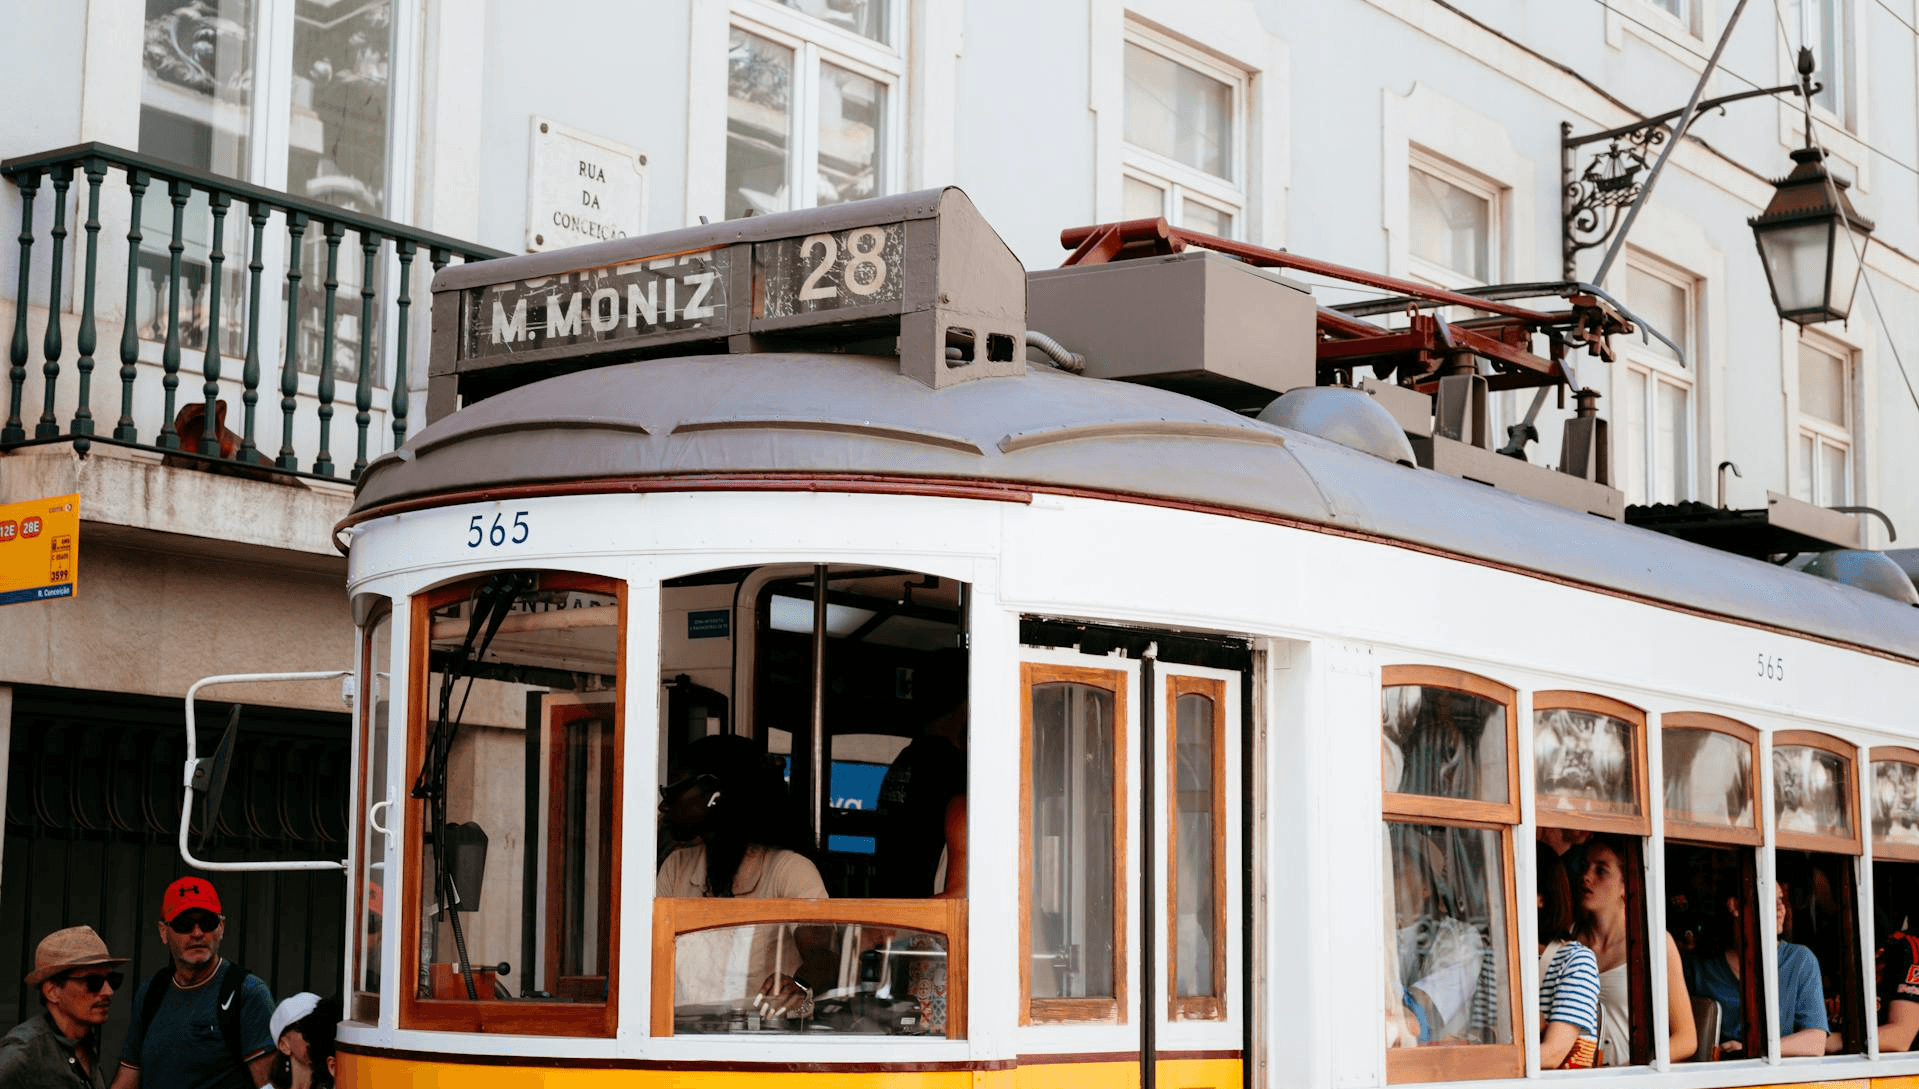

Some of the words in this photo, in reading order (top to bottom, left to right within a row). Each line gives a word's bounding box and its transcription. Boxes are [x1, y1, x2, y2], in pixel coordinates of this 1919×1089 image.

[578, 160, 606, 183] RUA
[581, 190, 600, 210] DA
[799, 226, 887, 301] 28
[23, 521, 40, 534] 28E
[467, 511, 529, 548] 565
[51, 570, 68, 581] 3599
[1757, 653, 1784, 681] 565
